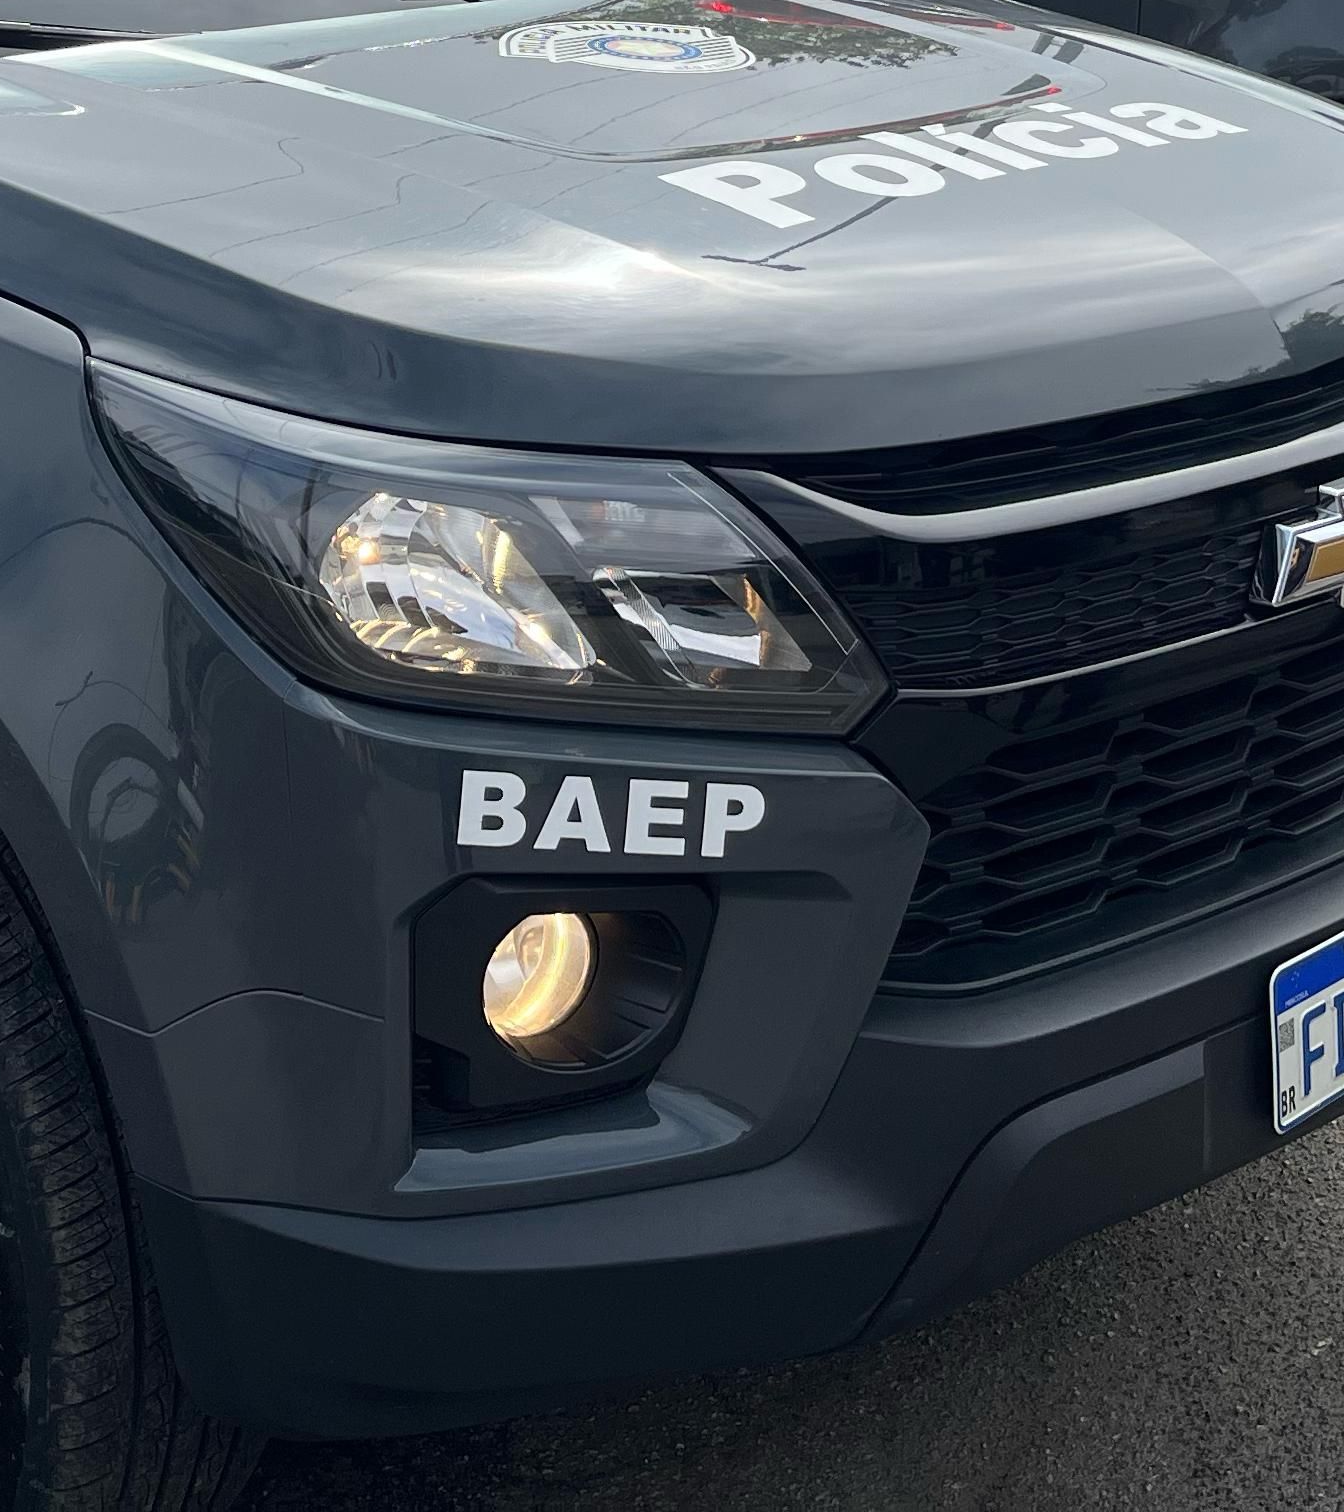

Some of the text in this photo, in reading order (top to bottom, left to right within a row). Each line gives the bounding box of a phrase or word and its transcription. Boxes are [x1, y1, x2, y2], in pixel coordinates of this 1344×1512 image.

[658, 100, 1249, 229] Polícia
[456, 768, 767, 859] BAEP
[1280, 1085, 1297, 1118] BR
